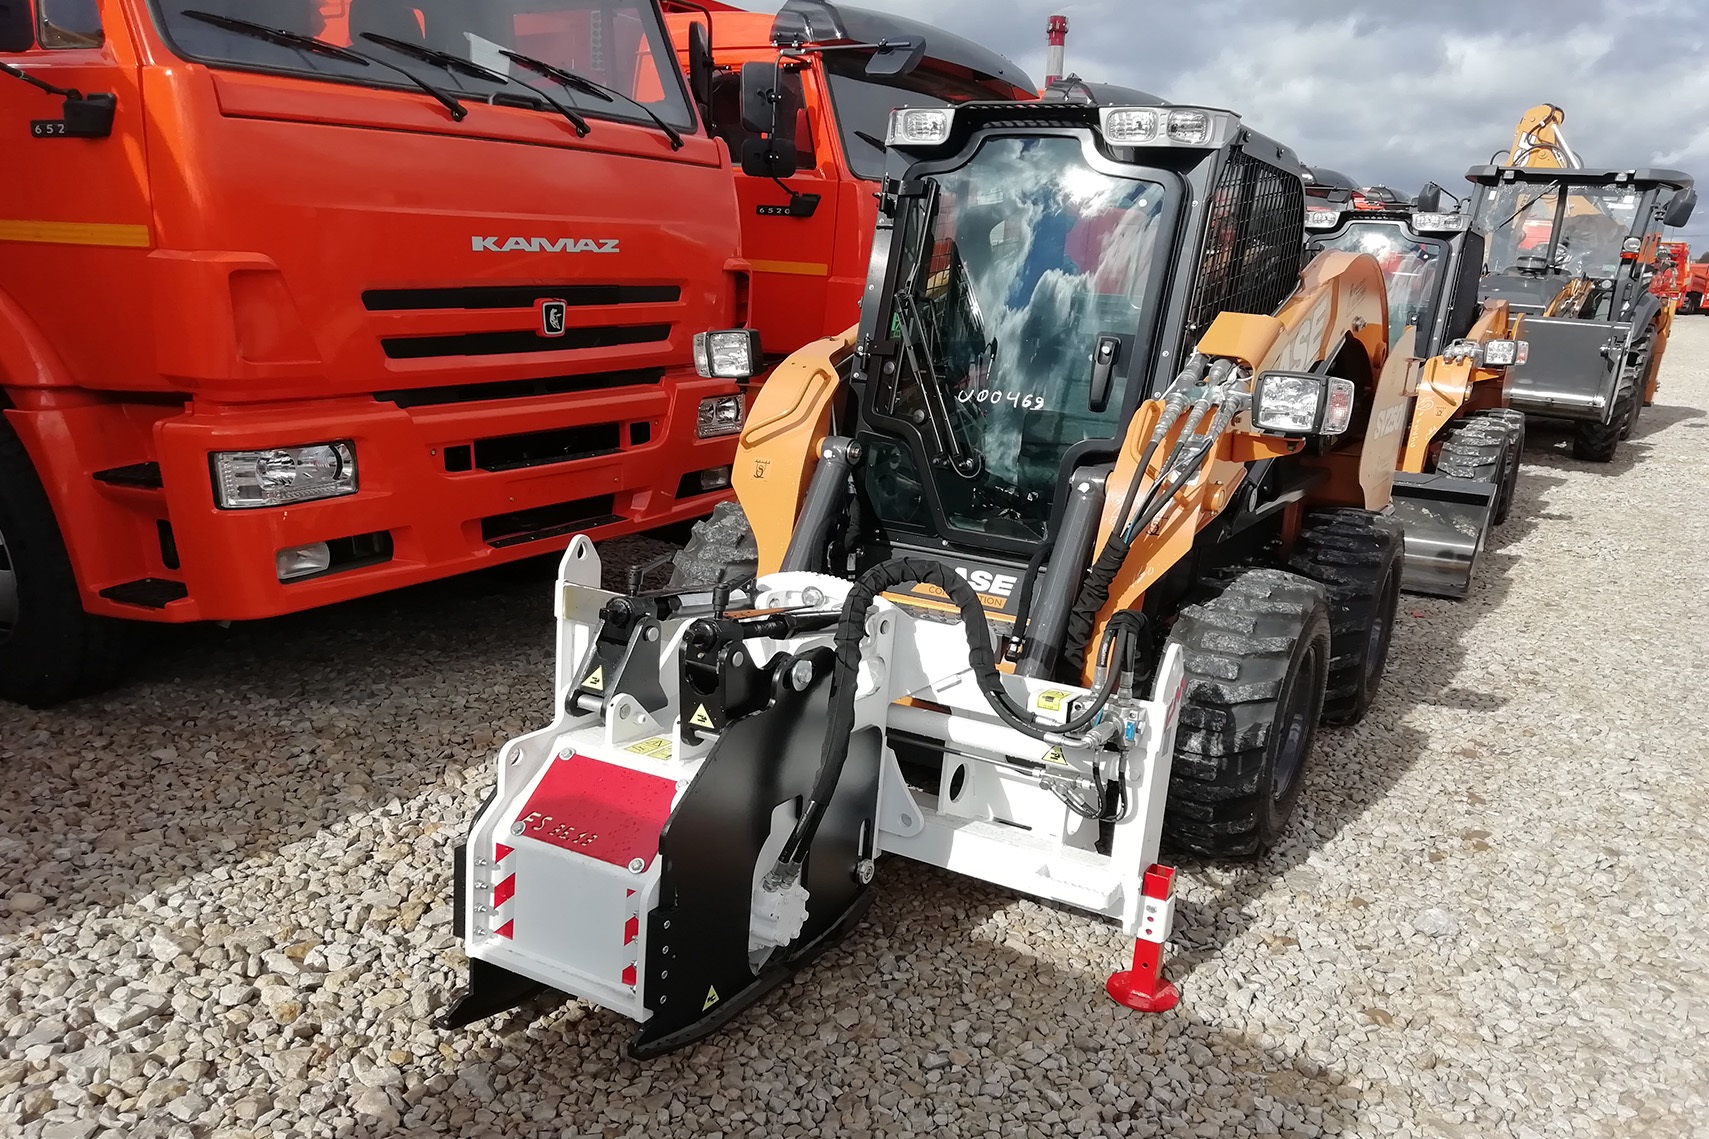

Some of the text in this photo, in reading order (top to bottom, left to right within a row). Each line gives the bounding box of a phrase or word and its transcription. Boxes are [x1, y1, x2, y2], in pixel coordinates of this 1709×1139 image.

[759, 207, 791, 215] 6520
[471, 235, 620, 253] KAMAZ
[954, 566, 1018, 597] SE
